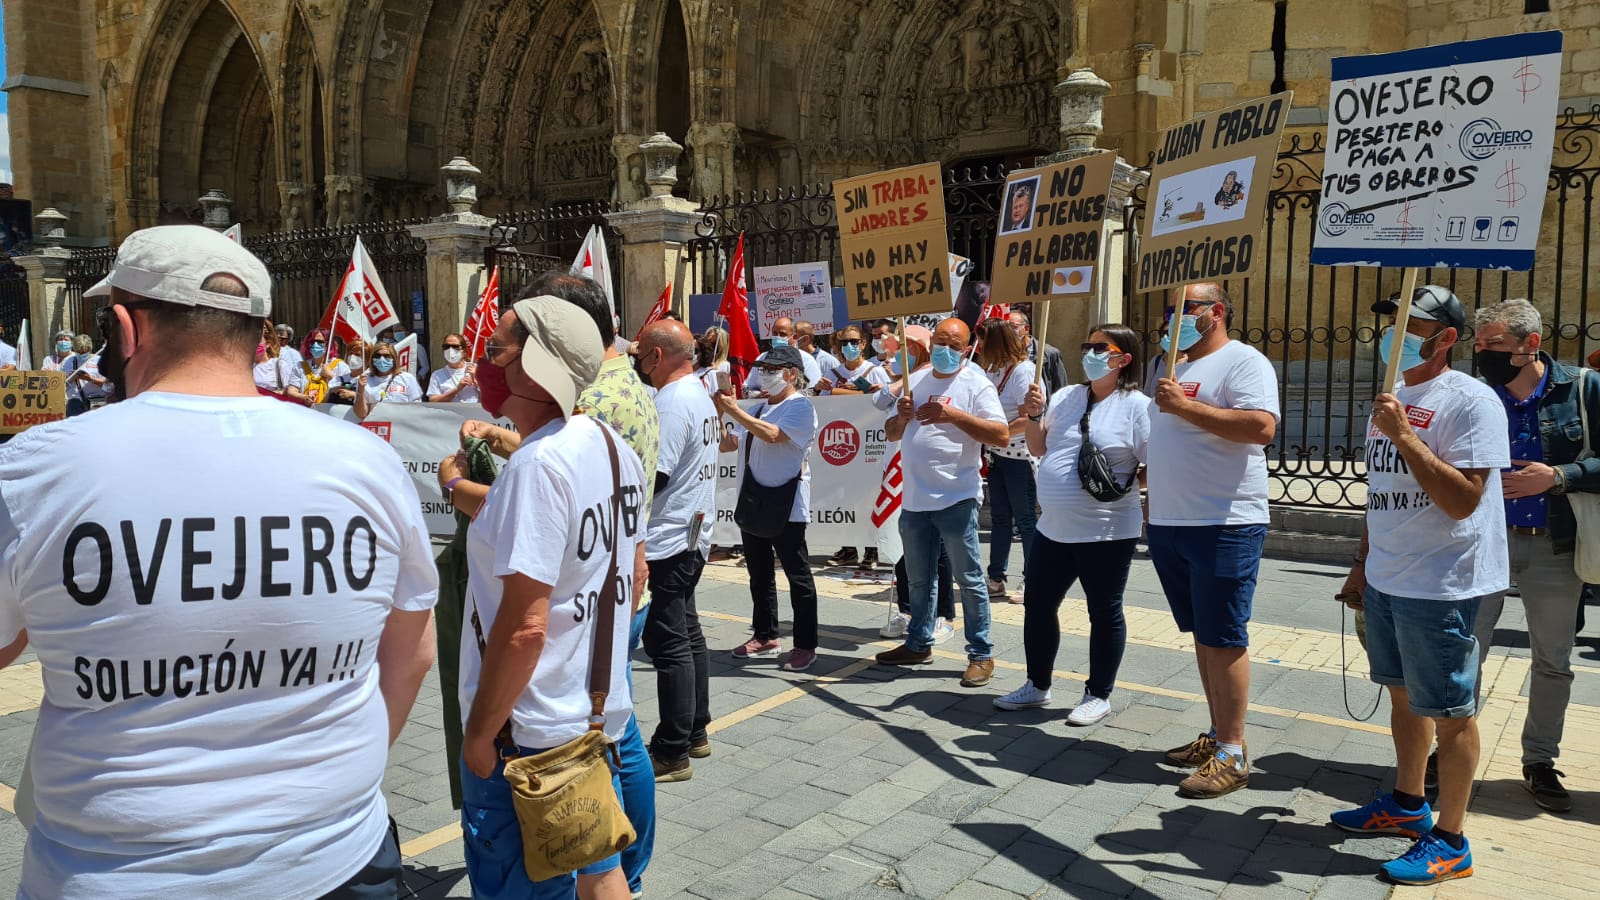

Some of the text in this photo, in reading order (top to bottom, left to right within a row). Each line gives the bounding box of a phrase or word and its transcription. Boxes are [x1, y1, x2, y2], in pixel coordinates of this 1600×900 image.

[1334, 75, 1494, 125] OVEJERO
[1157, 99, 1282, 164] JUAN PABLO
[1335, 120, 1443, 153] PESETERO
[1472, 129, 1533, 147] OVEJERO
[1348, 143, 1433, 168] PAGA A
[844, 174, 936, 214] SIN TRABA-
[1050, 164, 1086, 197] NO
[1324, 165, 1479, 198] TUS OBREROS
[850, 202, 929, 235] JADORES
[1036, 193, 1104, 228] TIENES
[1329, 212, 1375, 226] OVEJERO
[852, 239, 928, 271] NO HAY
[1006, 230, 1098, 268] PALABRA
[857, 267, 944, 308] EMPRESA
[1026, 269, 1050, 296] NI
[3, 390, 48, 410] O TÚ
[824, 428, 855, 446] UGT
[865, 429, 888, 442] FIC
[719, 465, 737, 478] DE
[817, 507, 856, 524] LEÓN
[1392, 492, 1409, 510] YA
[62, 515, 377, 606] OVEJERO
[74, 638, 364, 703] SOLUCIÓN YA !!!
